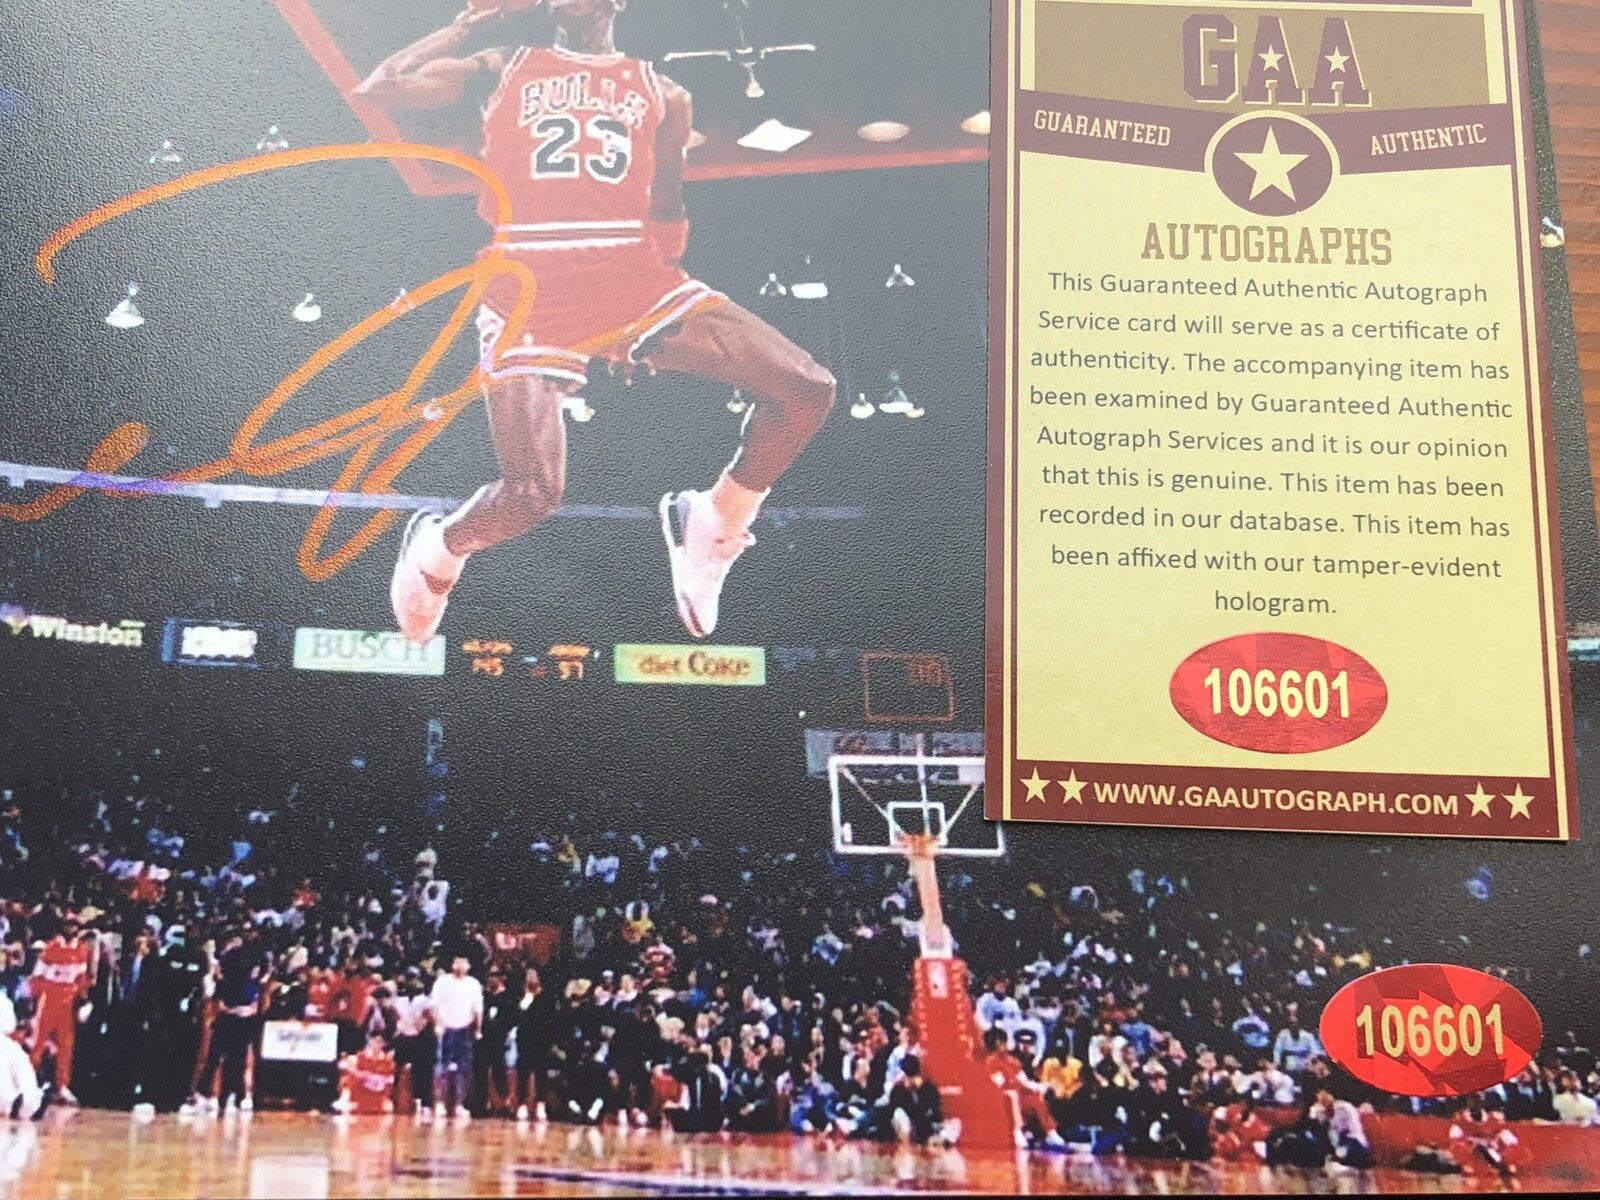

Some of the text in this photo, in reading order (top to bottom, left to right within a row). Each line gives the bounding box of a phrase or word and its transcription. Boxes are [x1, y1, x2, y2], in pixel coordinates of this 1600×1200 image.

[1182, 13, 1372, 107] GAA
[518, 71, 649, 129] BULLS
[1033, 109, 1172, 148] GUARANTEED
[1370, 122, 1488, 156] AUTHENTIC
[530, 114, 633, 185] 23
[1141, 222, 1393, 266] AUTOGRAPHS
[1047, 271, 1488, 307] This Guaranteed Authentic Autograph
[1037, 310, 1501, 341] Service card will serve as a certificate of
[1030, 348, 1510, 382] authenticity. The accompanying item has
[1030, 384, 1513, 419] been examined by Guaranteed Authentic
[1036, 425, 1508, 461] Autograph Services and it is our opinion
[1041, 463, 1504, 497] that this is genuine. This item has been
[1039, 505, 1510, 538] recorded in our database. This item has
[1051, 543, 1502, 580] been affixed with our tamper-evident
[1214, 589, 1337, 618] hologram.
[1203, 667, 1350, 719] 106601
[1092, 781, 1460, 816] WWW.GAAUTOGRAPH.COM
[1355, 1002, 1505, 1058] 106601
